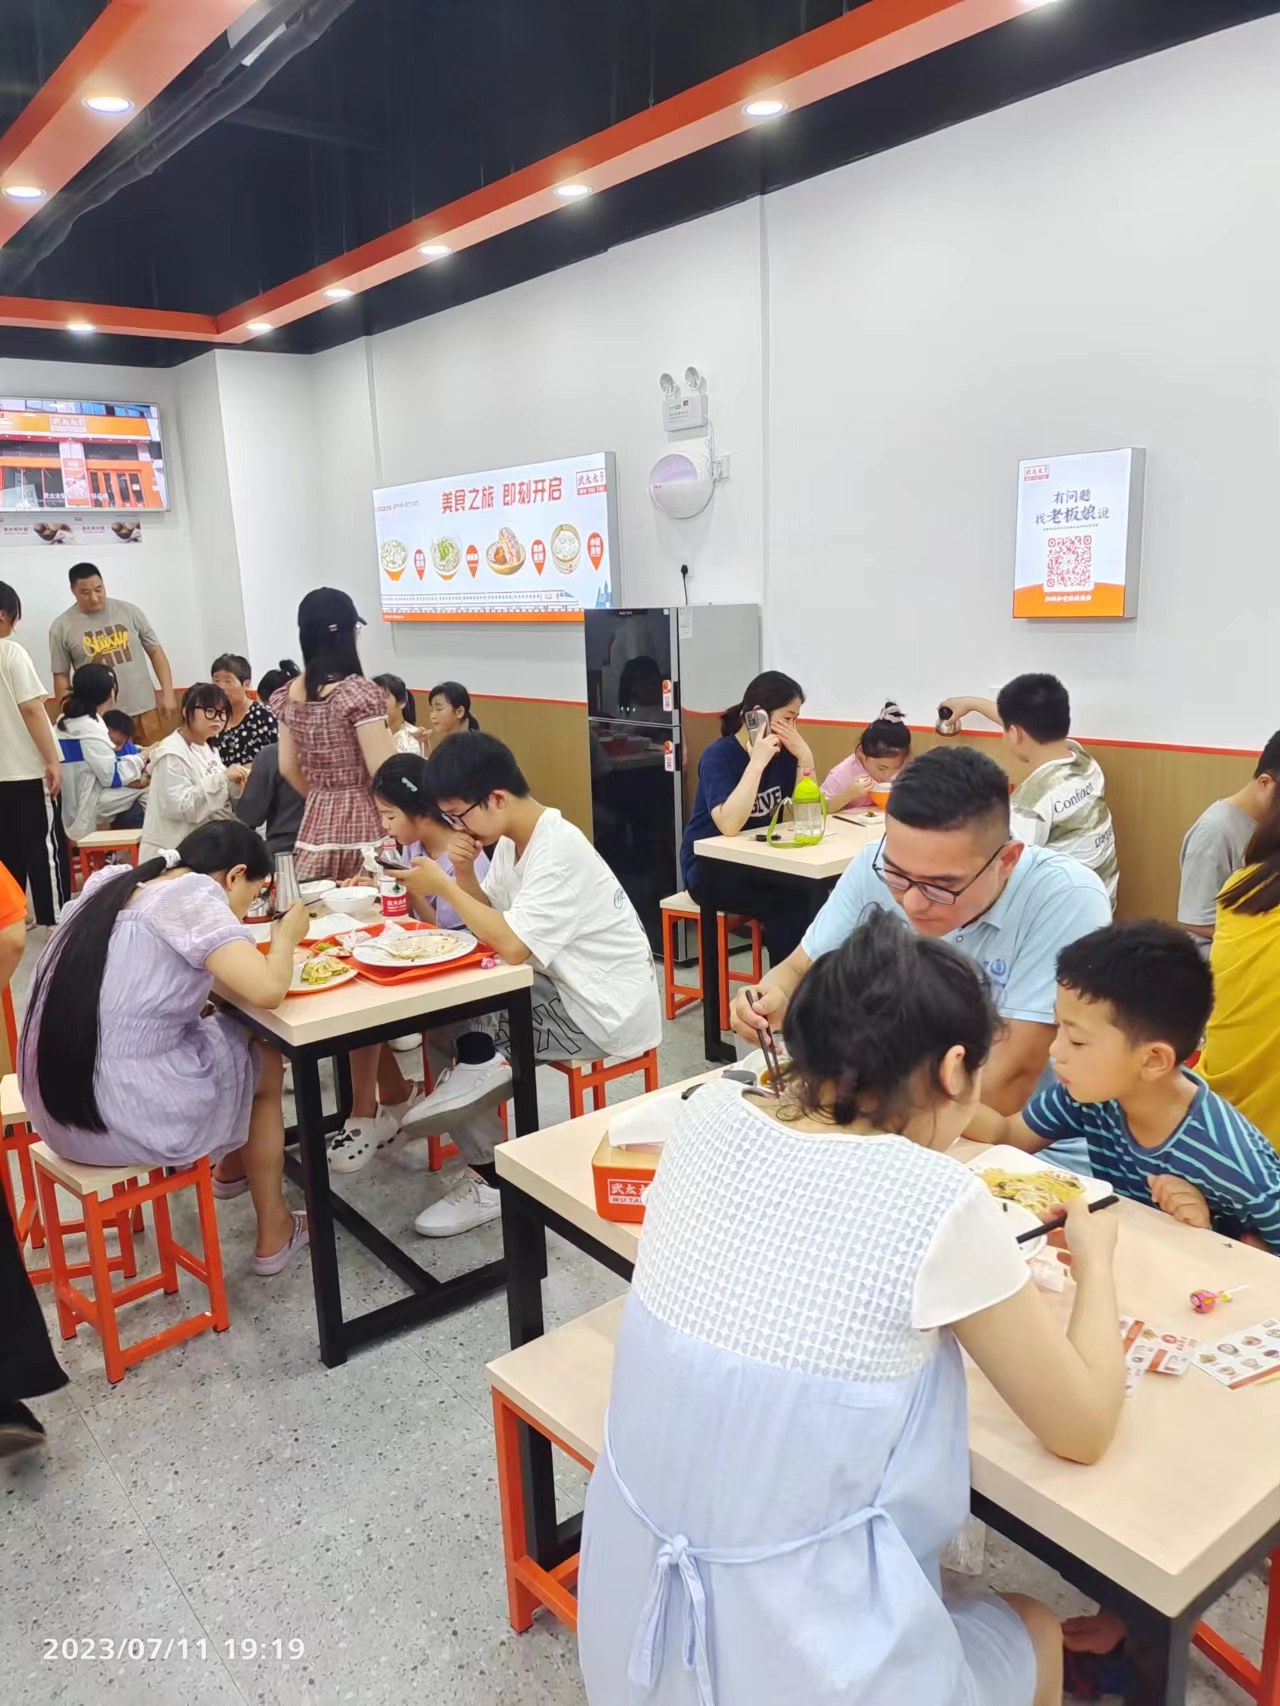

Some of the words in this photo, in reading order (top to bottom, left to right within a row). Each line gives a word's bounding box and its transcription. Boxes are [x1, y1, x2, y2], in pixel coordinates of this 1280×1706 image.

[442, 486, 494, 514] 美食之旅
[503, 477, 561, 506] 即刻开启
[1053, 489, 1090, 504] 有问题
[1035, 504, 1109, 524] 找老板娘说
